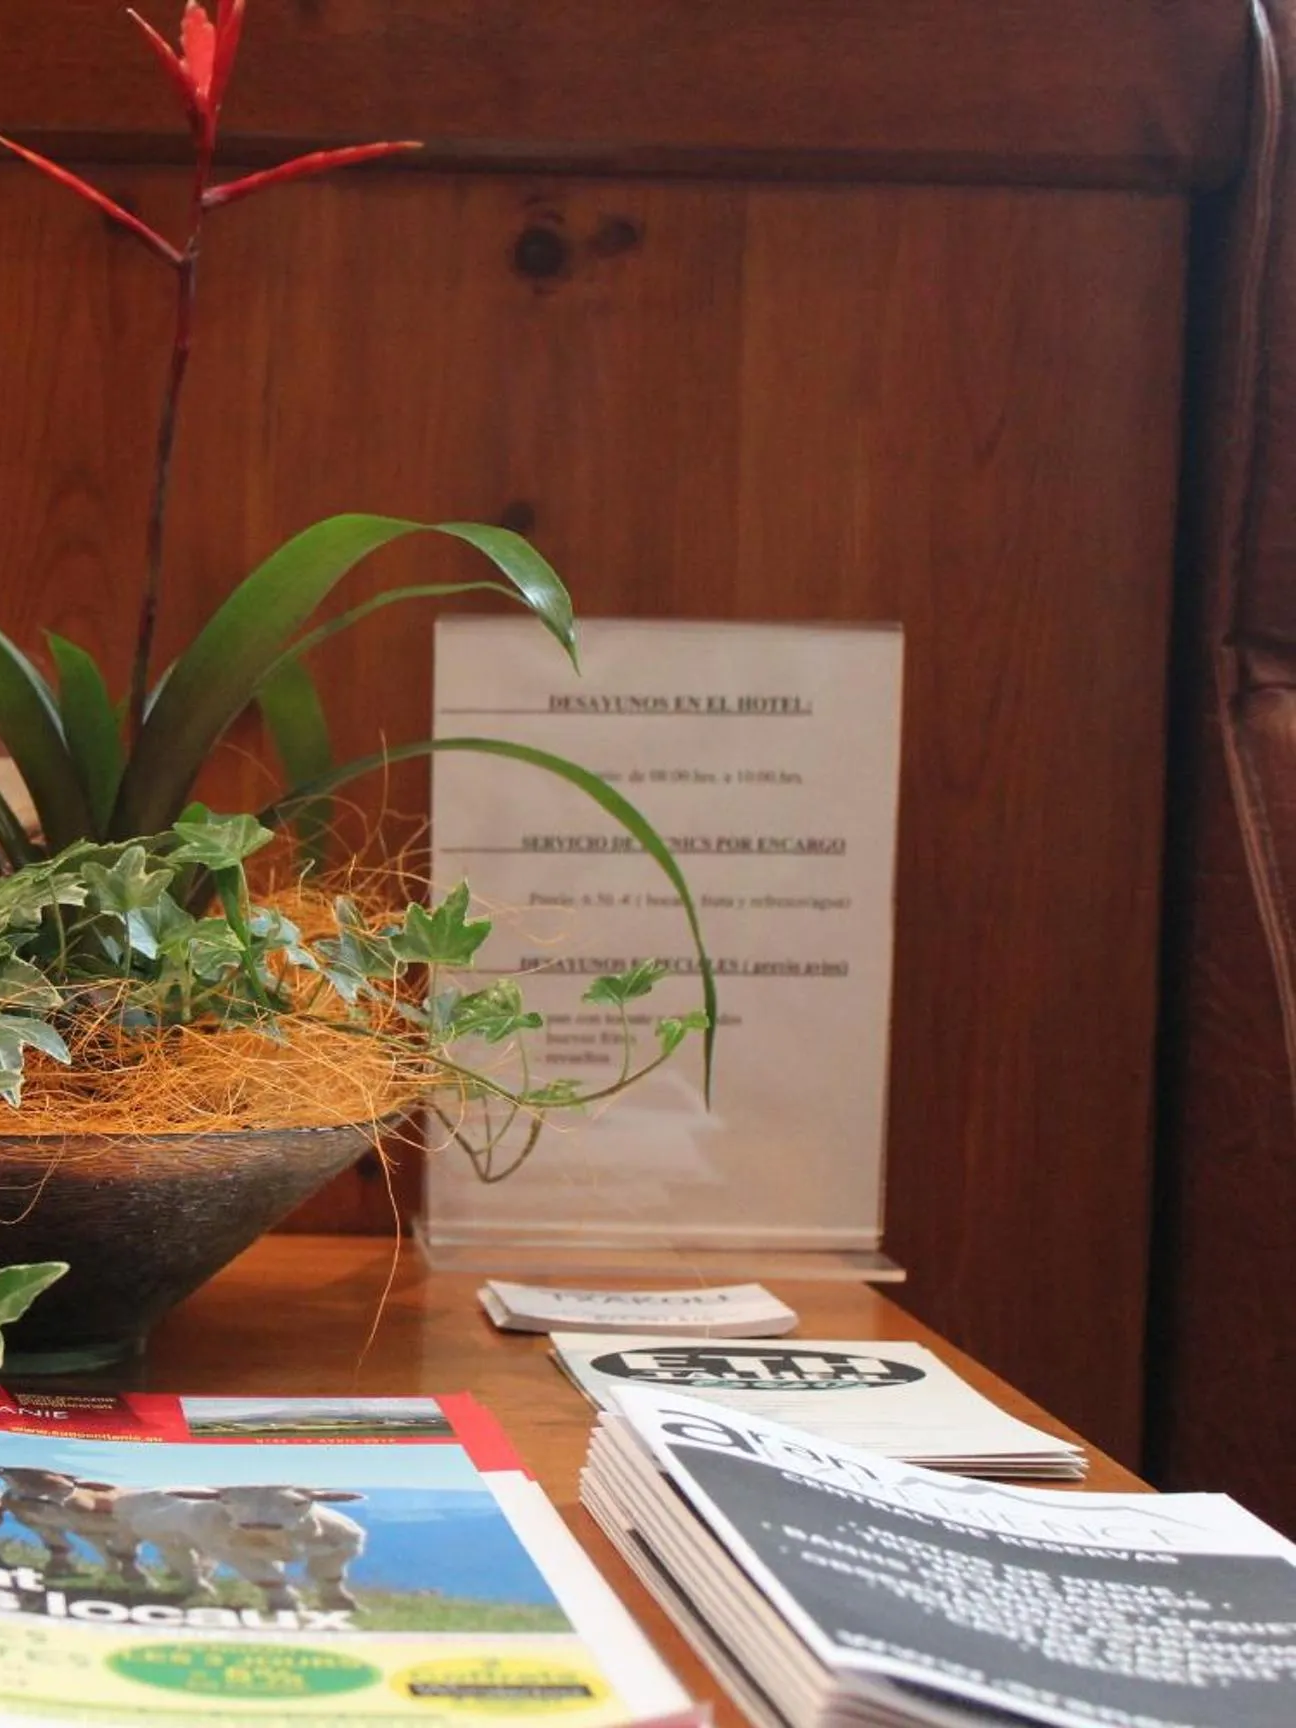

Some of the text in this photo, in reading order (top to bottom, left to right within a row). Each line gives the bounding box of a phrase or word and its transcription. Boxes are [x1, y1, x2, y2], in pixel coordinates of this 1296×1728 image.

[549, 694, 668, 714] DESAYUNOS
[673, 695, 701, 714] EN
[706, 696, 732, 714] EL
[521, 836, 608, 853] SERVICIO
[611, 836, 634, 853] DE
[716, 836, 751, 854] POR
[757, 837, 846, 855] ENCARGO
[631, 957, 739, 975] EPECILES
[781, 1471, 1180, 1565] CENTRAL DE RESERVAS
[46, 1591, 359, 1632] locaux
